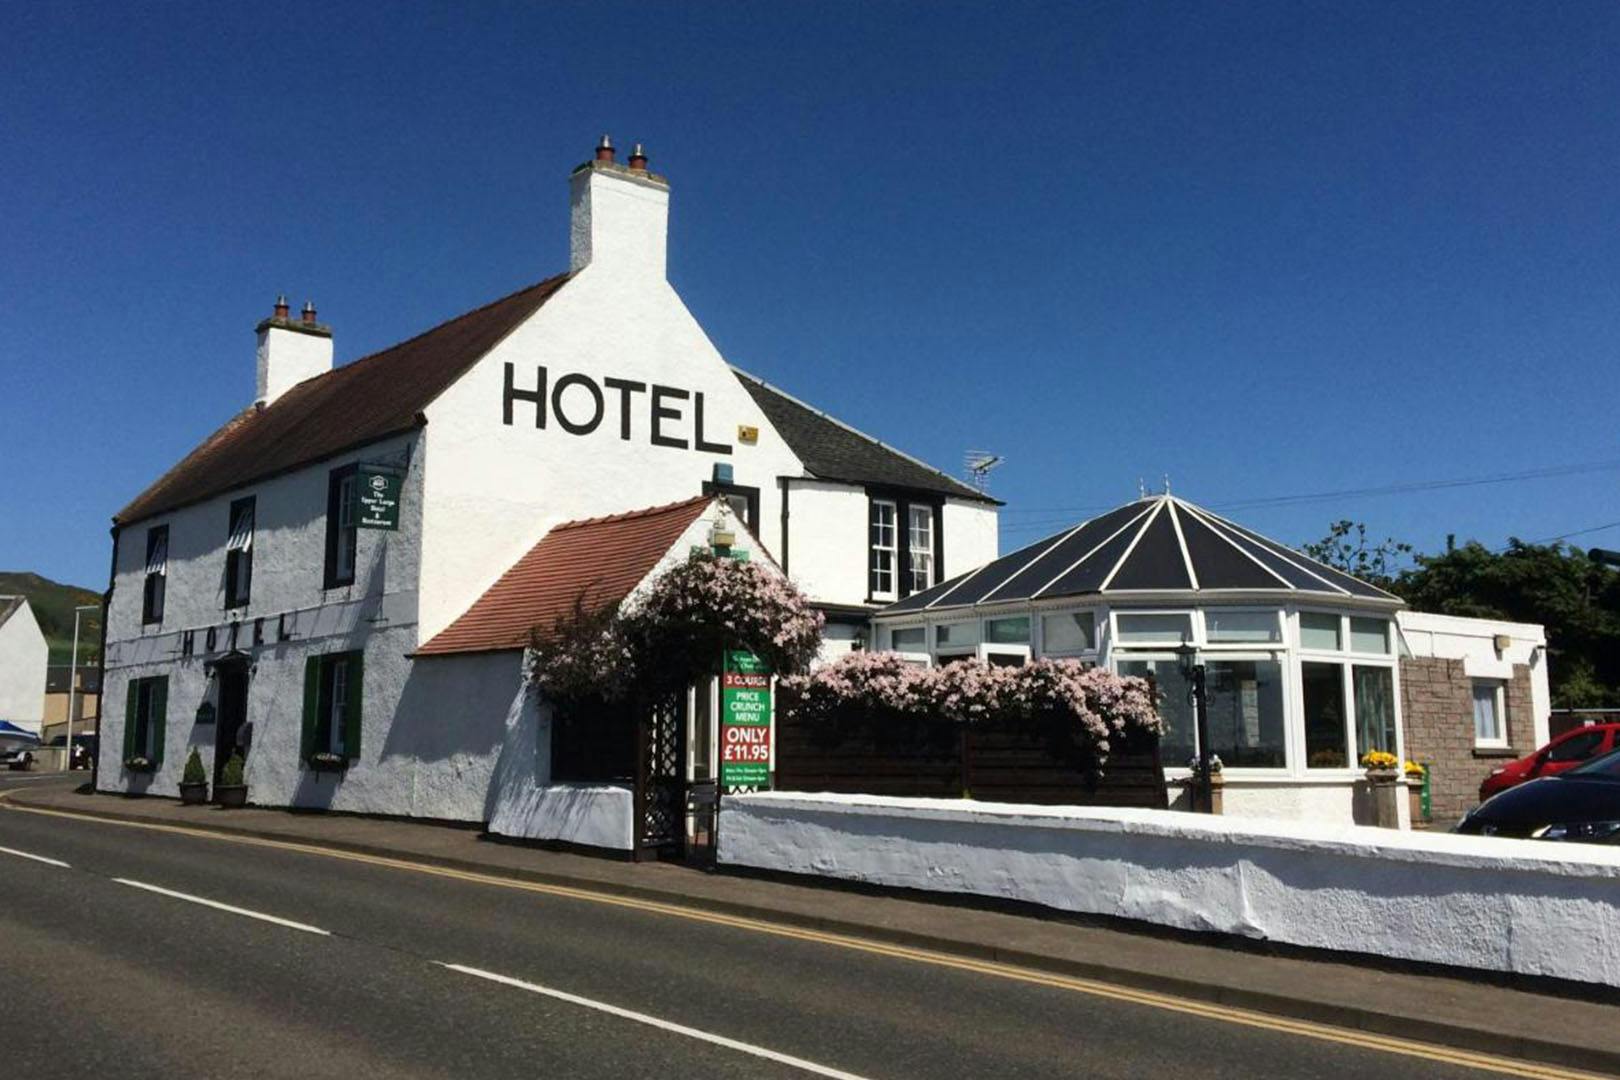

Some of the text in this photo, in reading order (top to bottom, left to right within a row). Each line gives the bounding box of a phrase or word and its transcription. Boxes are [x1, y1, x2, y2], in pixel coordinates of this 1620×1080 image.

[502, 361, 733, 456] HOTEL
[183, 613, 291, 658] HOTEL
[727, 675, 733, 685] 3
[736, 692, 760, 701] PRICE
[730, 701, 766, 712] CRUNCH
[735, 712, 760, 722] MENU
[726, 727, 767, 743] ONLY
[724, 744, 769, 760] £11.95
